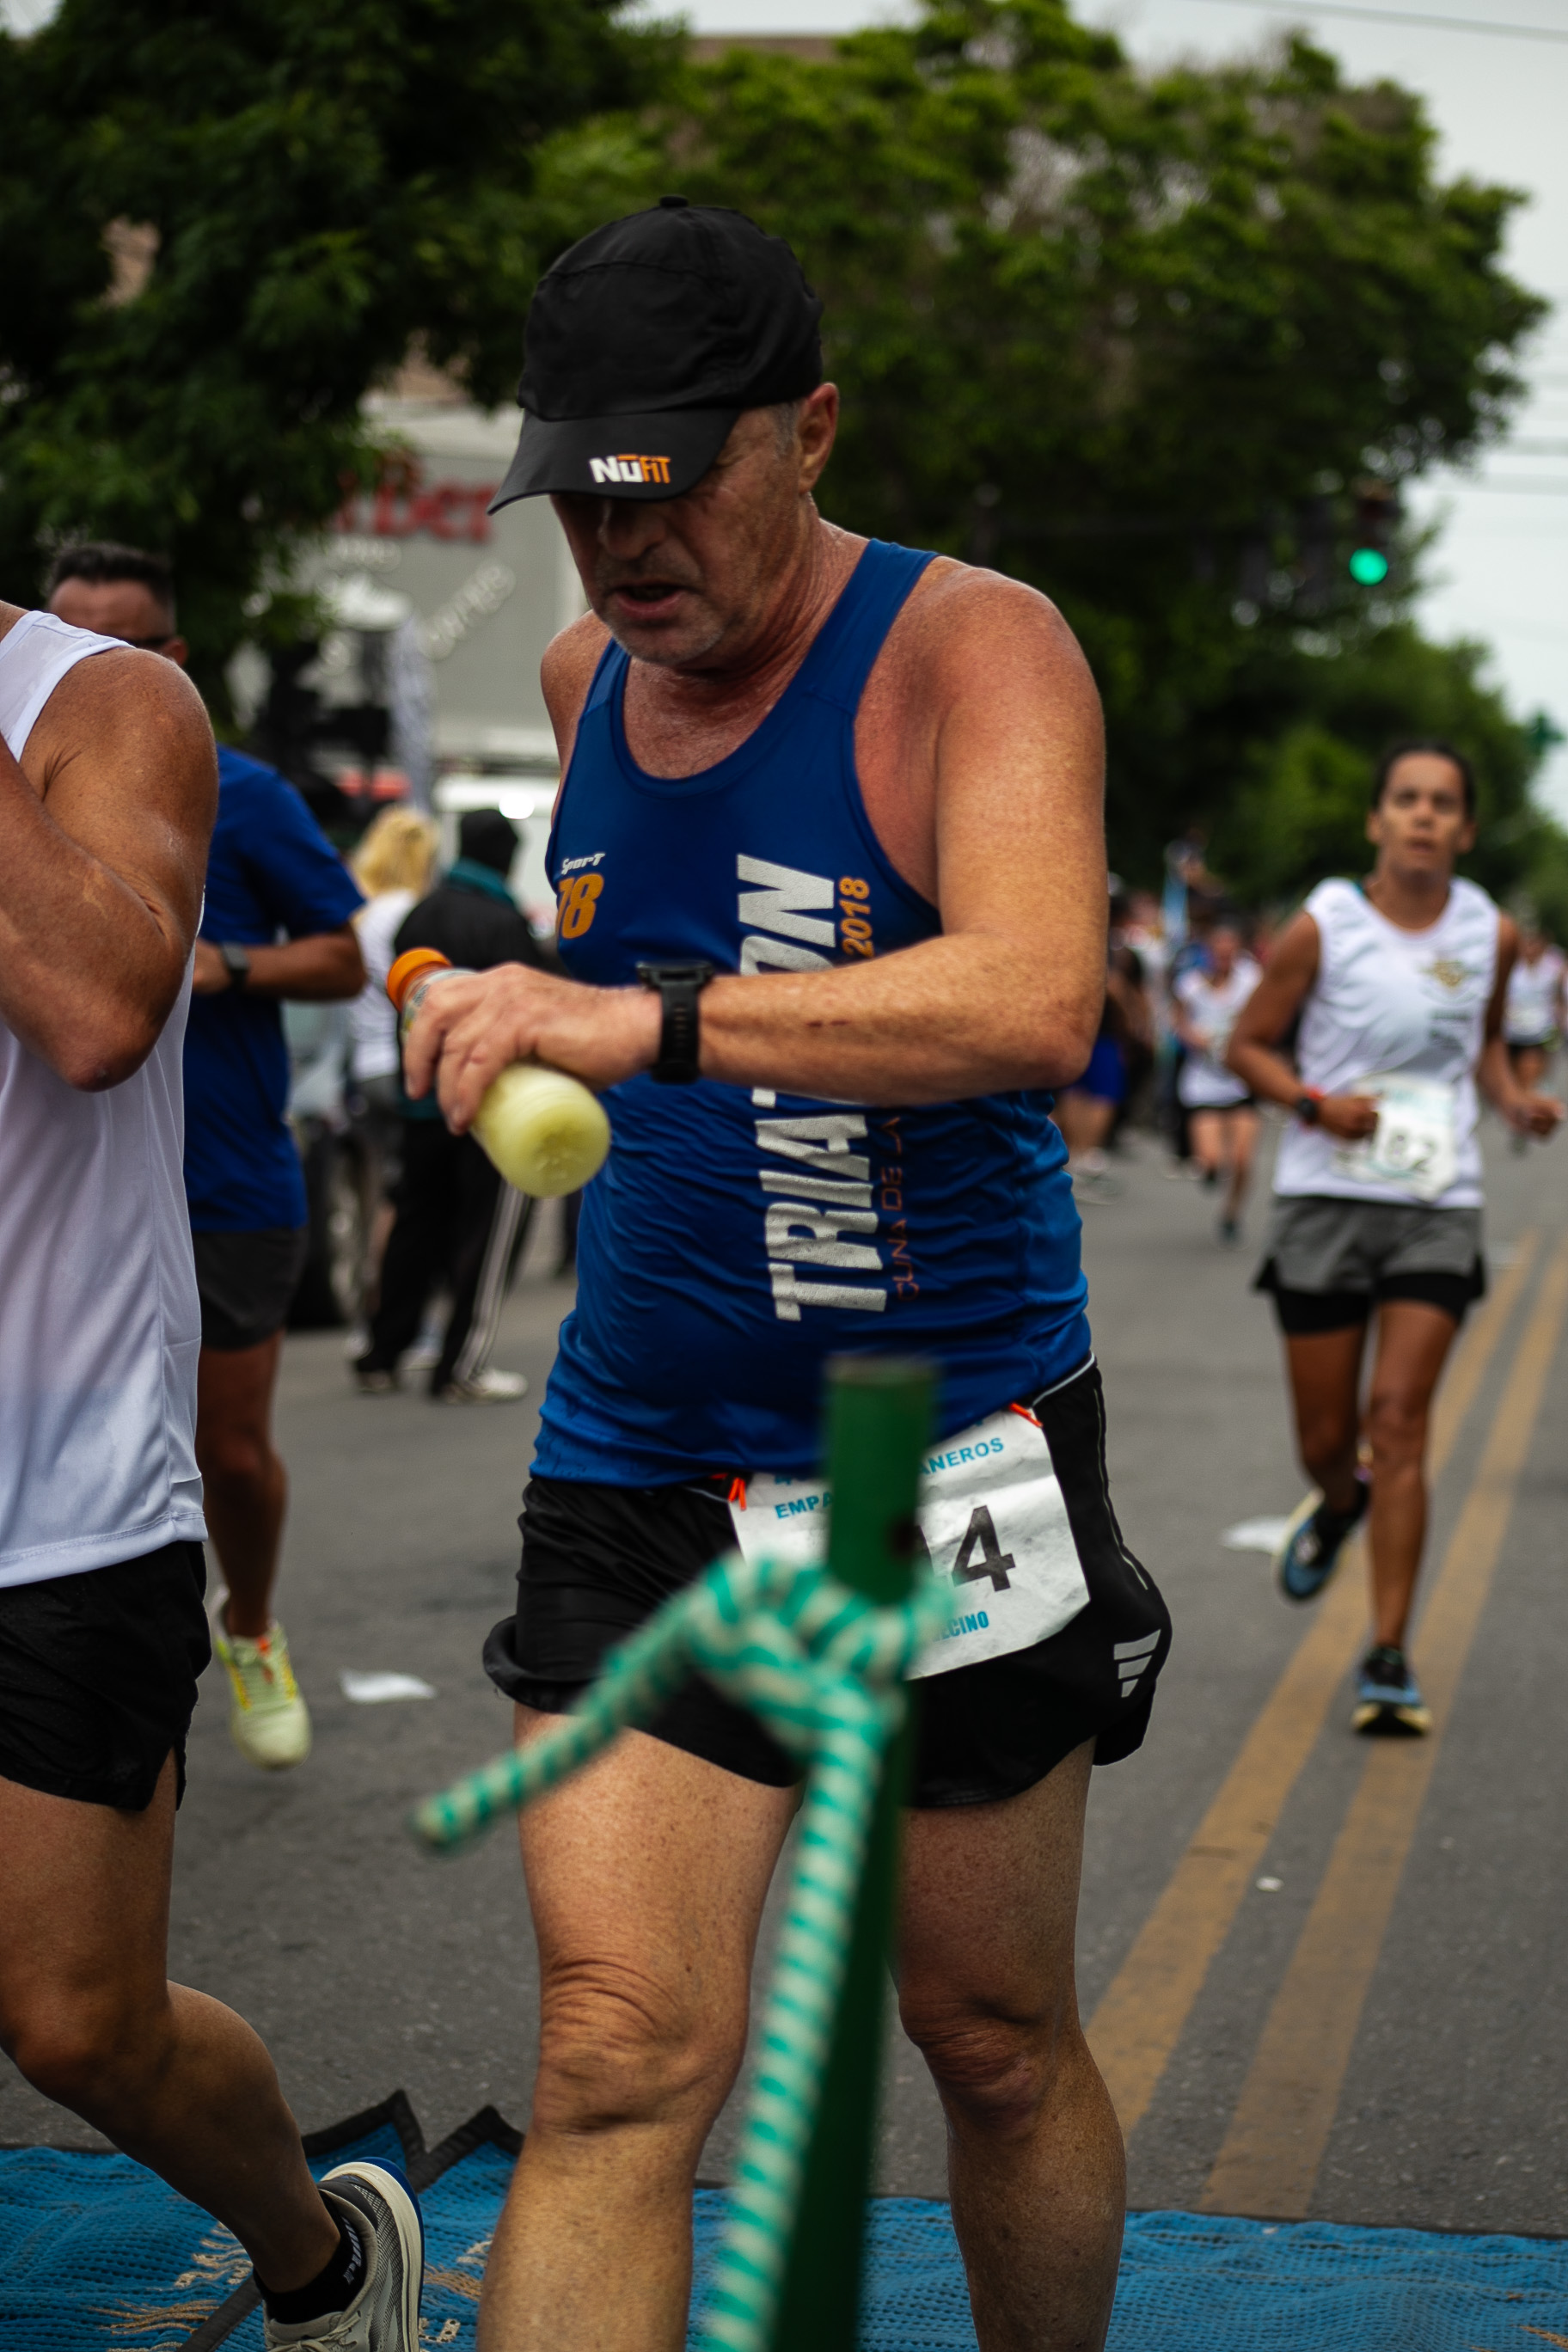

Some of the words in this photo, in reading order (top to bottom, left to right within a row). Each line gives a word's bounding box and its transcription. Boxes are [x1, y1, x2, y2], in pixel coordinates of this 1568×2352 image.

[839, 876, 875, 959] 2018
[881, 1166, 903, 1210] DE
[887, 1218, 919, 1301] CUNA
